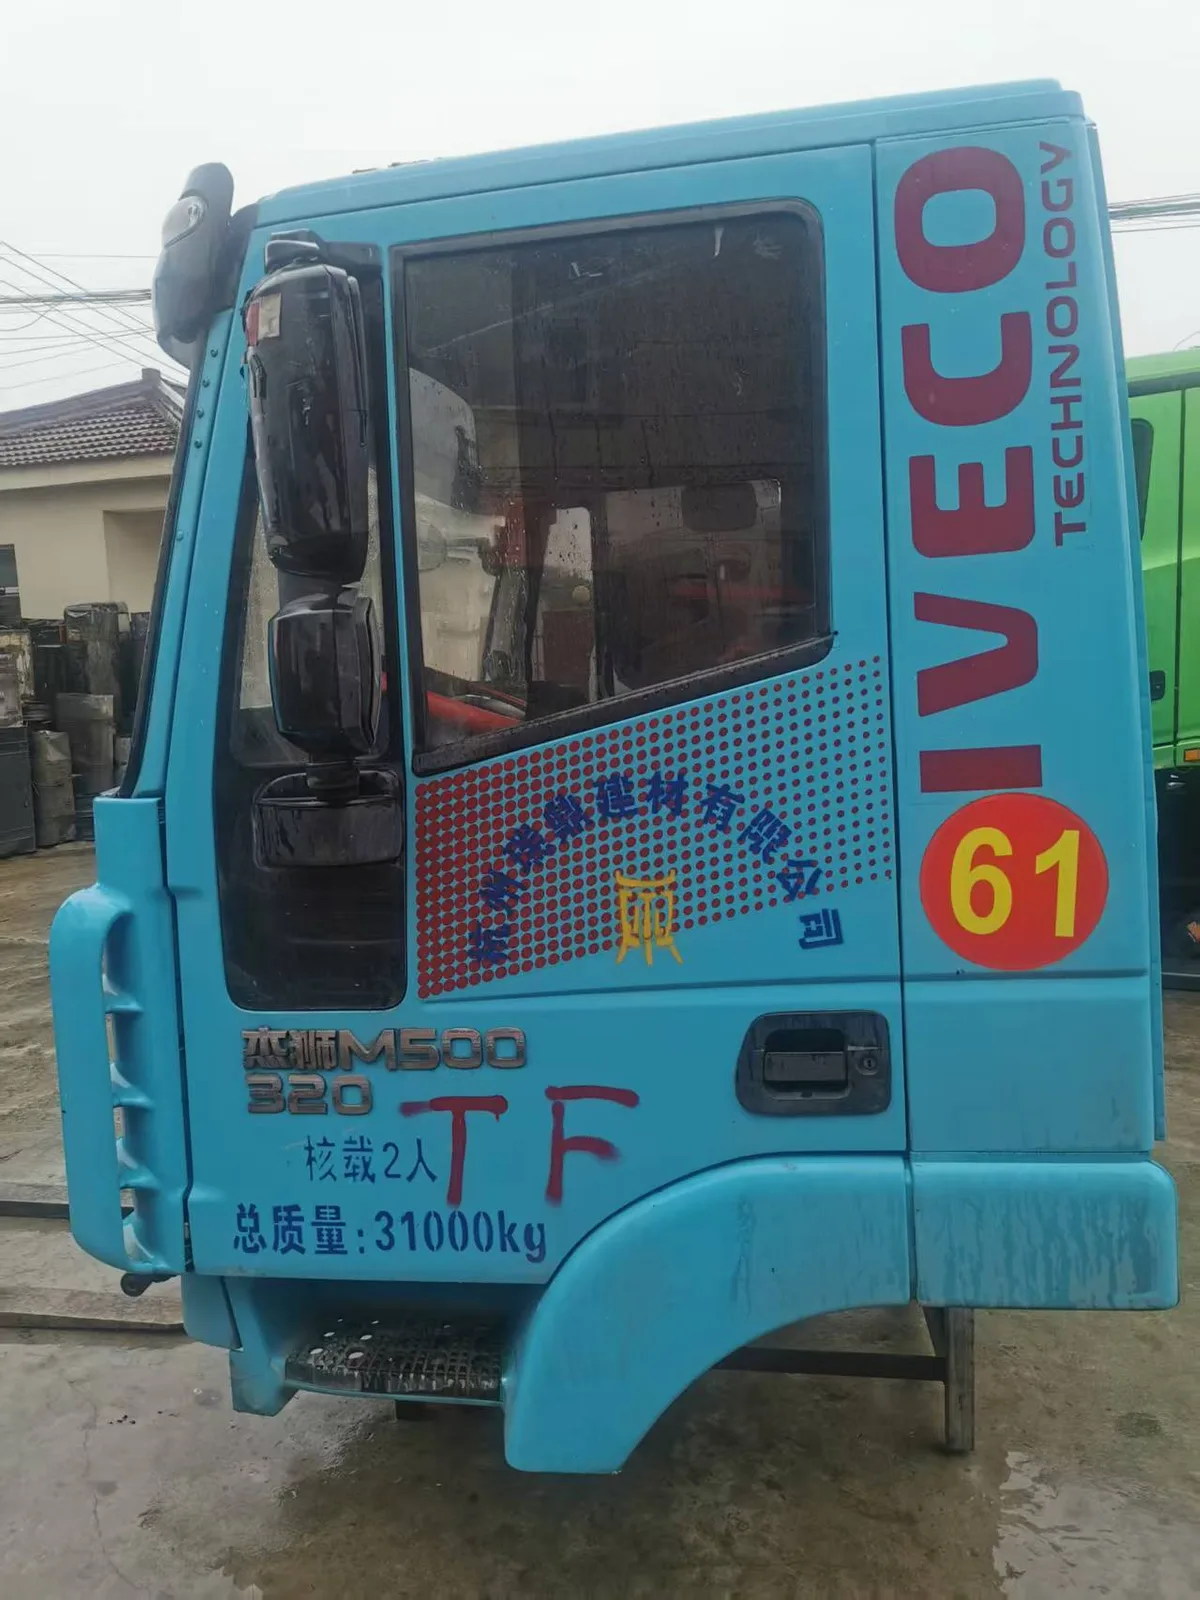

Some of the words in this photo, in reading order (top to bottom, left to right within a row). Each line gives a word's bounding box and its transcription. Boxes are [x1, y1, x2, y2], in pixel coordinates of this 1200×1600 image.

[1039, 140, 1088, 548] TECHNOLOGY
[894, 146, 1042, 793] IVECO
[950, 827, 1081, 938] 61
[241, 1026, 527, 1071] 杰狮M500
[247, 1073, 373, 1115] 320
[303, 1135, 438, 1185] 核载2人
